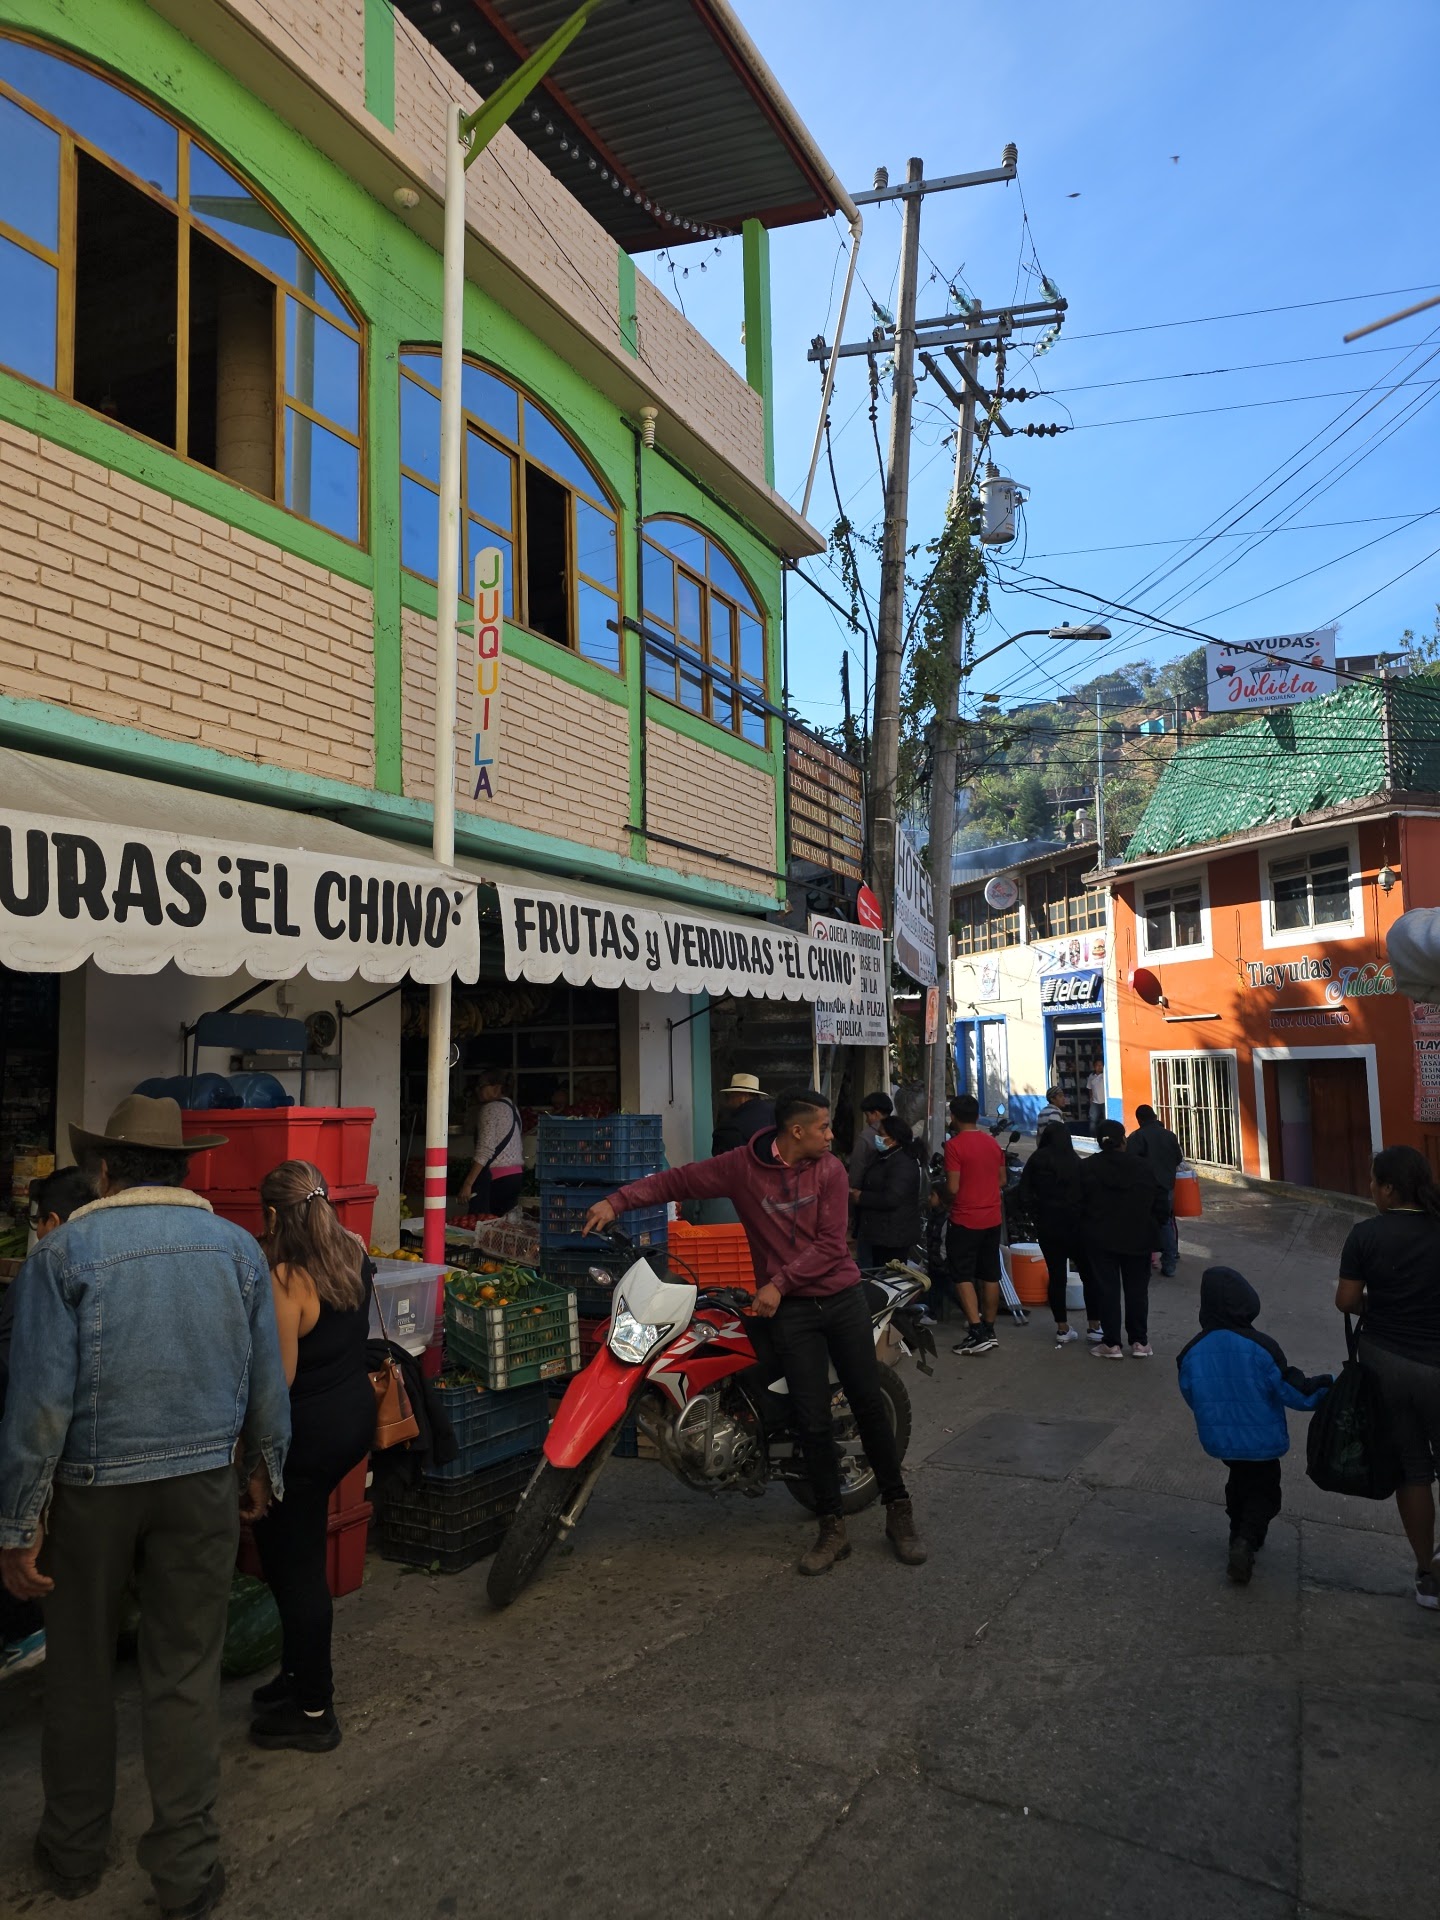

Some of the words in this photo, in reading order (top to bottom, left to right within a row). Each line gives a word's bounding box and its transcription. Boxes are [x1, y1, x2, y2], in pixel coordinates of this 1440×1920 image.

[1223, 637, 1315, 656] TLAYUDAS
[473, 555, 499, 800] JUQUILA
[1228, 673, 1318, 702] Julieta
[828, 753, 860, 783] TLAYUDAS
[790, 773, 802, 790] LES
[802, 781, 827, 803] OFRECE:
[829, 773, 860, 804] HUARACHES
[791, 795, 812, 817] PANCITA
[811, 805, 819, 818] DE
[829, 793, 861, 822] MEMELITAS
[791, 839, 810, 859] CARNES
[810, 847, 828, 865] ASADAS
[896, 832, 934, 926] HOTEL
[513, 898, 640, 961] FRUTAS
[646, 930, 661, 971] y
[664, 920, 774, 976] VERDURAS
[828, 925, 848, 943] QUEDA
[851, 930, 881, 951] PROHIBIDO
[873, 957, 881, 972] EN
[1246, 956, 1332, 991] Tlayudas
[860, 977, 868, 993] EN
[869, 978, 878, 994] LA
[1053, 973, 1096, 1002] telcel
[1325, 963, 1397, 1004] Julieta
[849, 999, 855, 1014] A
[866, 1001, 885, 1017] PLAZA
[836, 1017, 863, 1037] PÚBLICA
